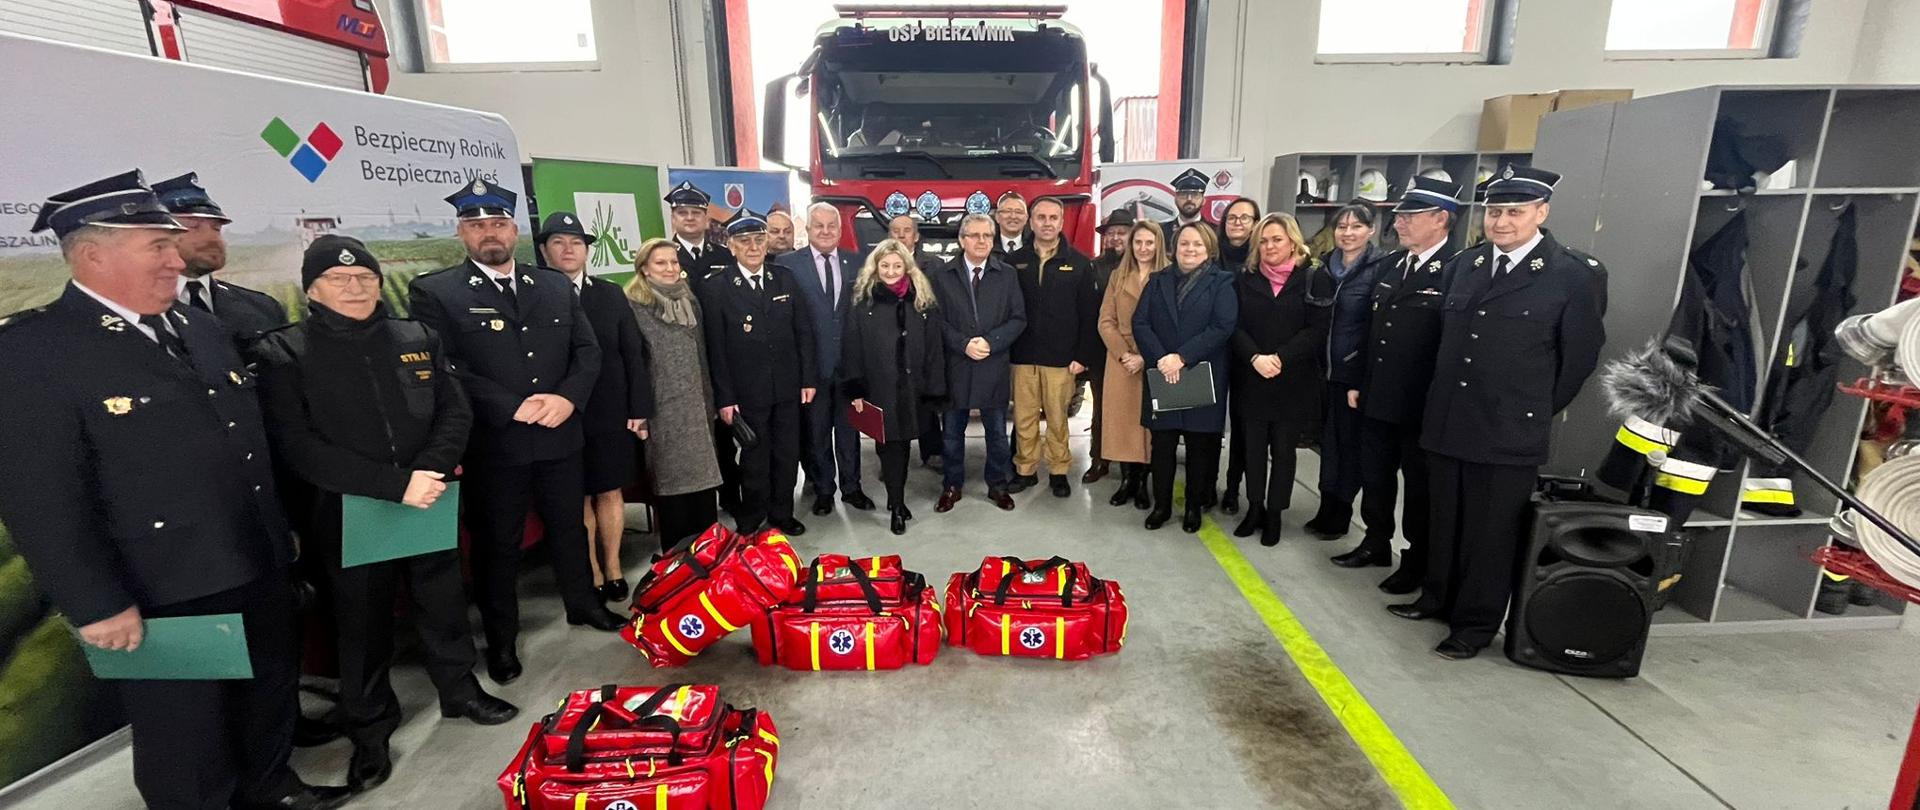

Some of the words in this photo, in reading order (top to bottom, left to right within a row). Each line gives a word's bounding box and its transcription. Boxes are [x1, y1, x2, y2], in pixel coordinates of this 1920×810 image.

[888, 26, 920, 42] OSP
[925, 25, 1015, 42] BIERZWNIK
[354, 125, 456, 160] Bezpieczny
[459, 138, 506, 160] Rolnik
[361, 159, 462, 187] Bezpieczna
[0, 202, 41, 214] EGO
